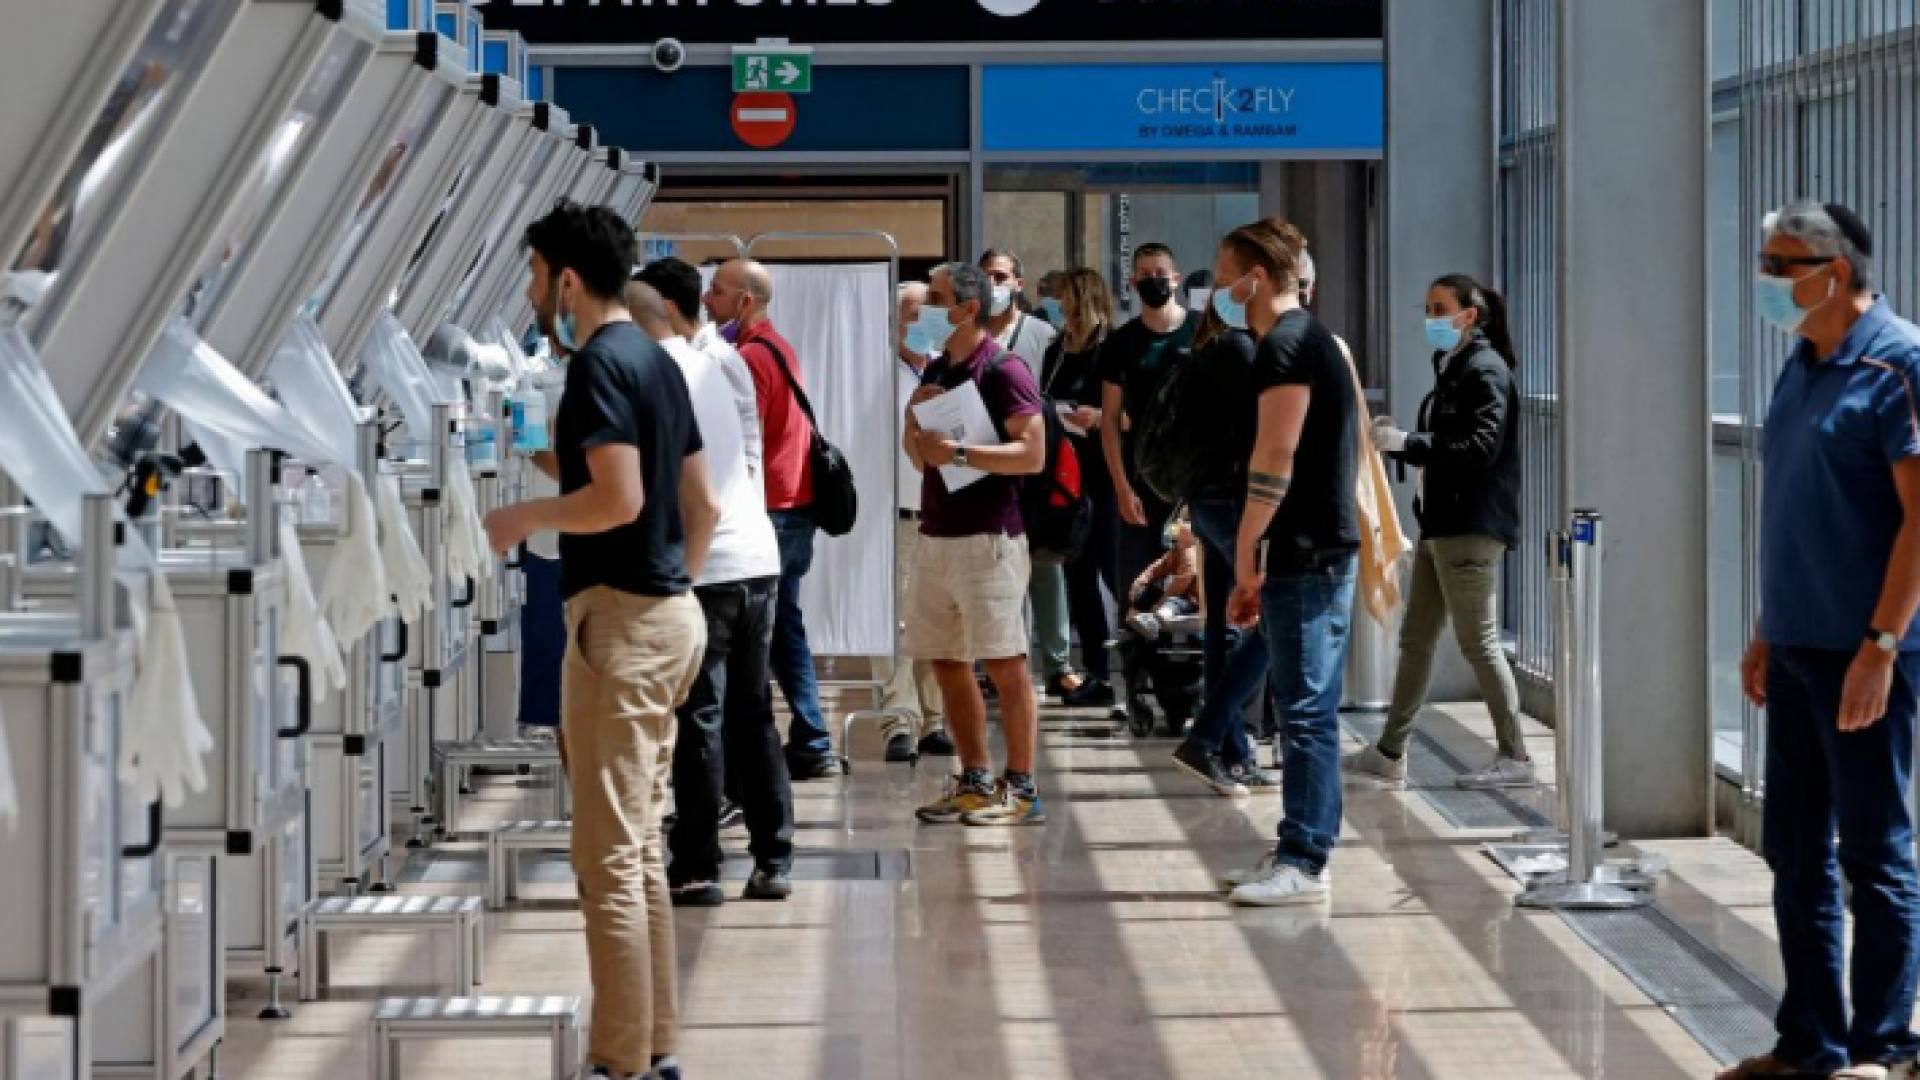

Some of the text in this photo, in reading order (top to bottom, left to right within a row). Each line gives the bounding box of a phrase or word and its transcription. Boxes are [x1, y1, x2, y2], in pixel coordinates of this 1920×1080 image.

[1136, 81, 1295, 120] CHECK2FLY
[1138, 124, 1297, 137] BY OMEGA & RAMBAM
